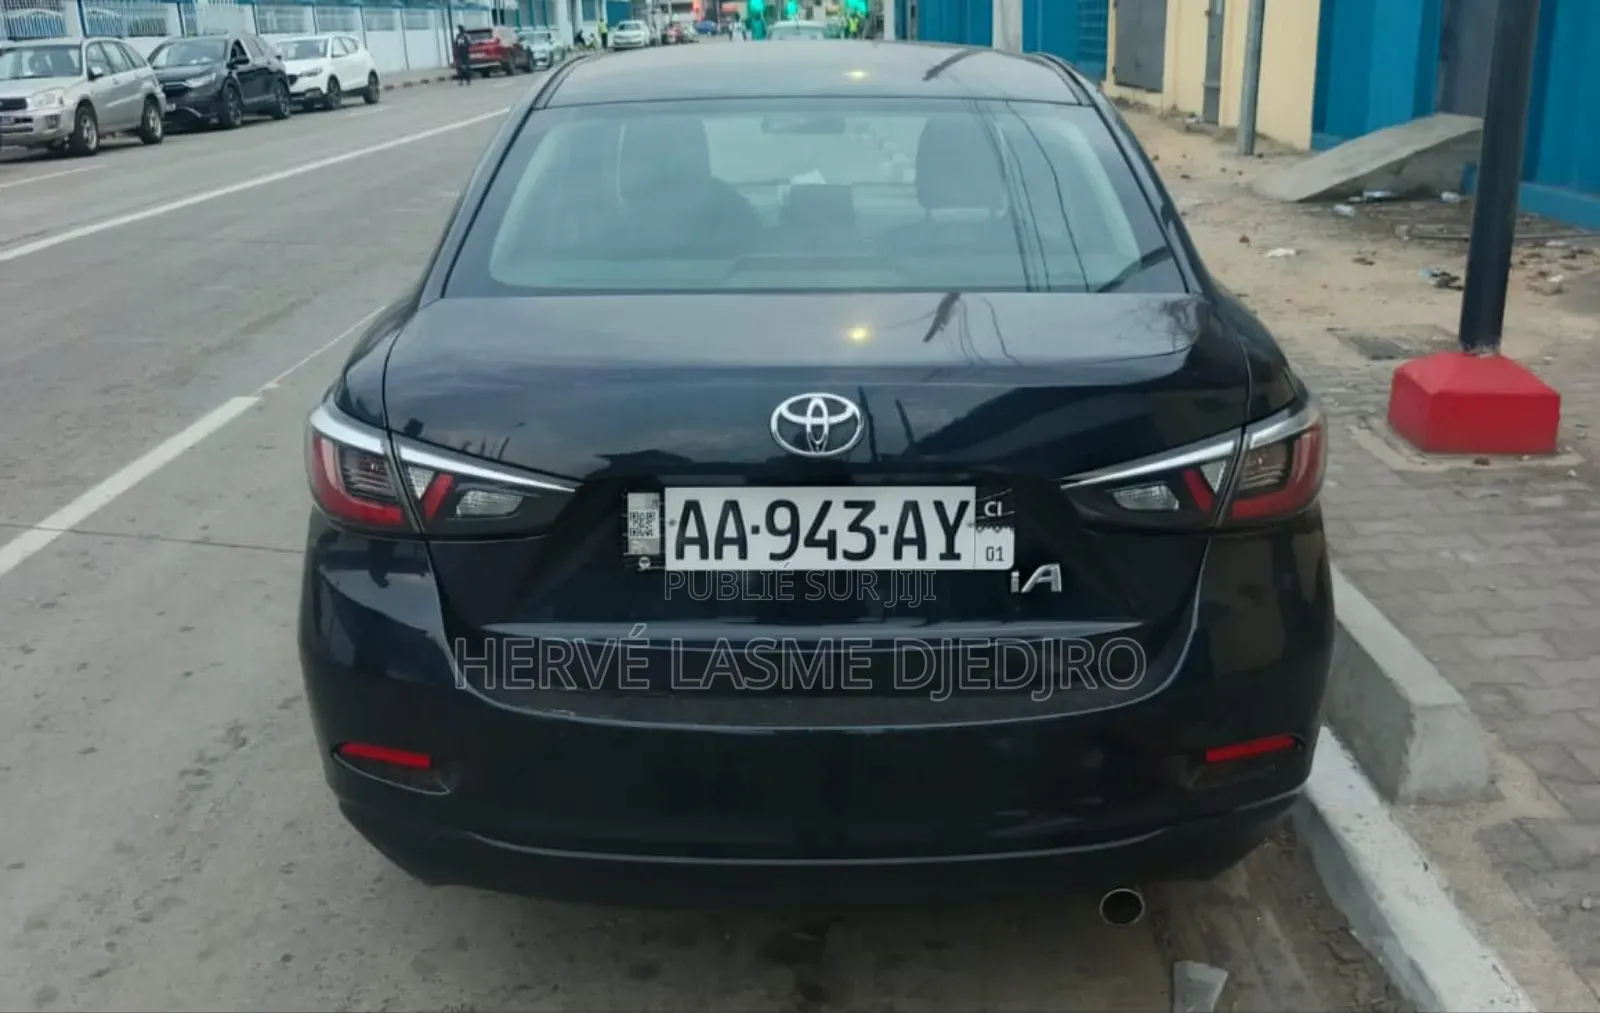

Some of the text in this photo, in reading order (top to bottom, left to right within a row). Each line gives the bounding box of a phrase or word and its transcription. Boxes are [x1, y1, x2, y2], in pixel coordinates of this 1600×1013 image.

[984, 500, 1003, 517] CI
[985, 546, 1004, 562] 01
[1010, 563, 1062, 593] iA
